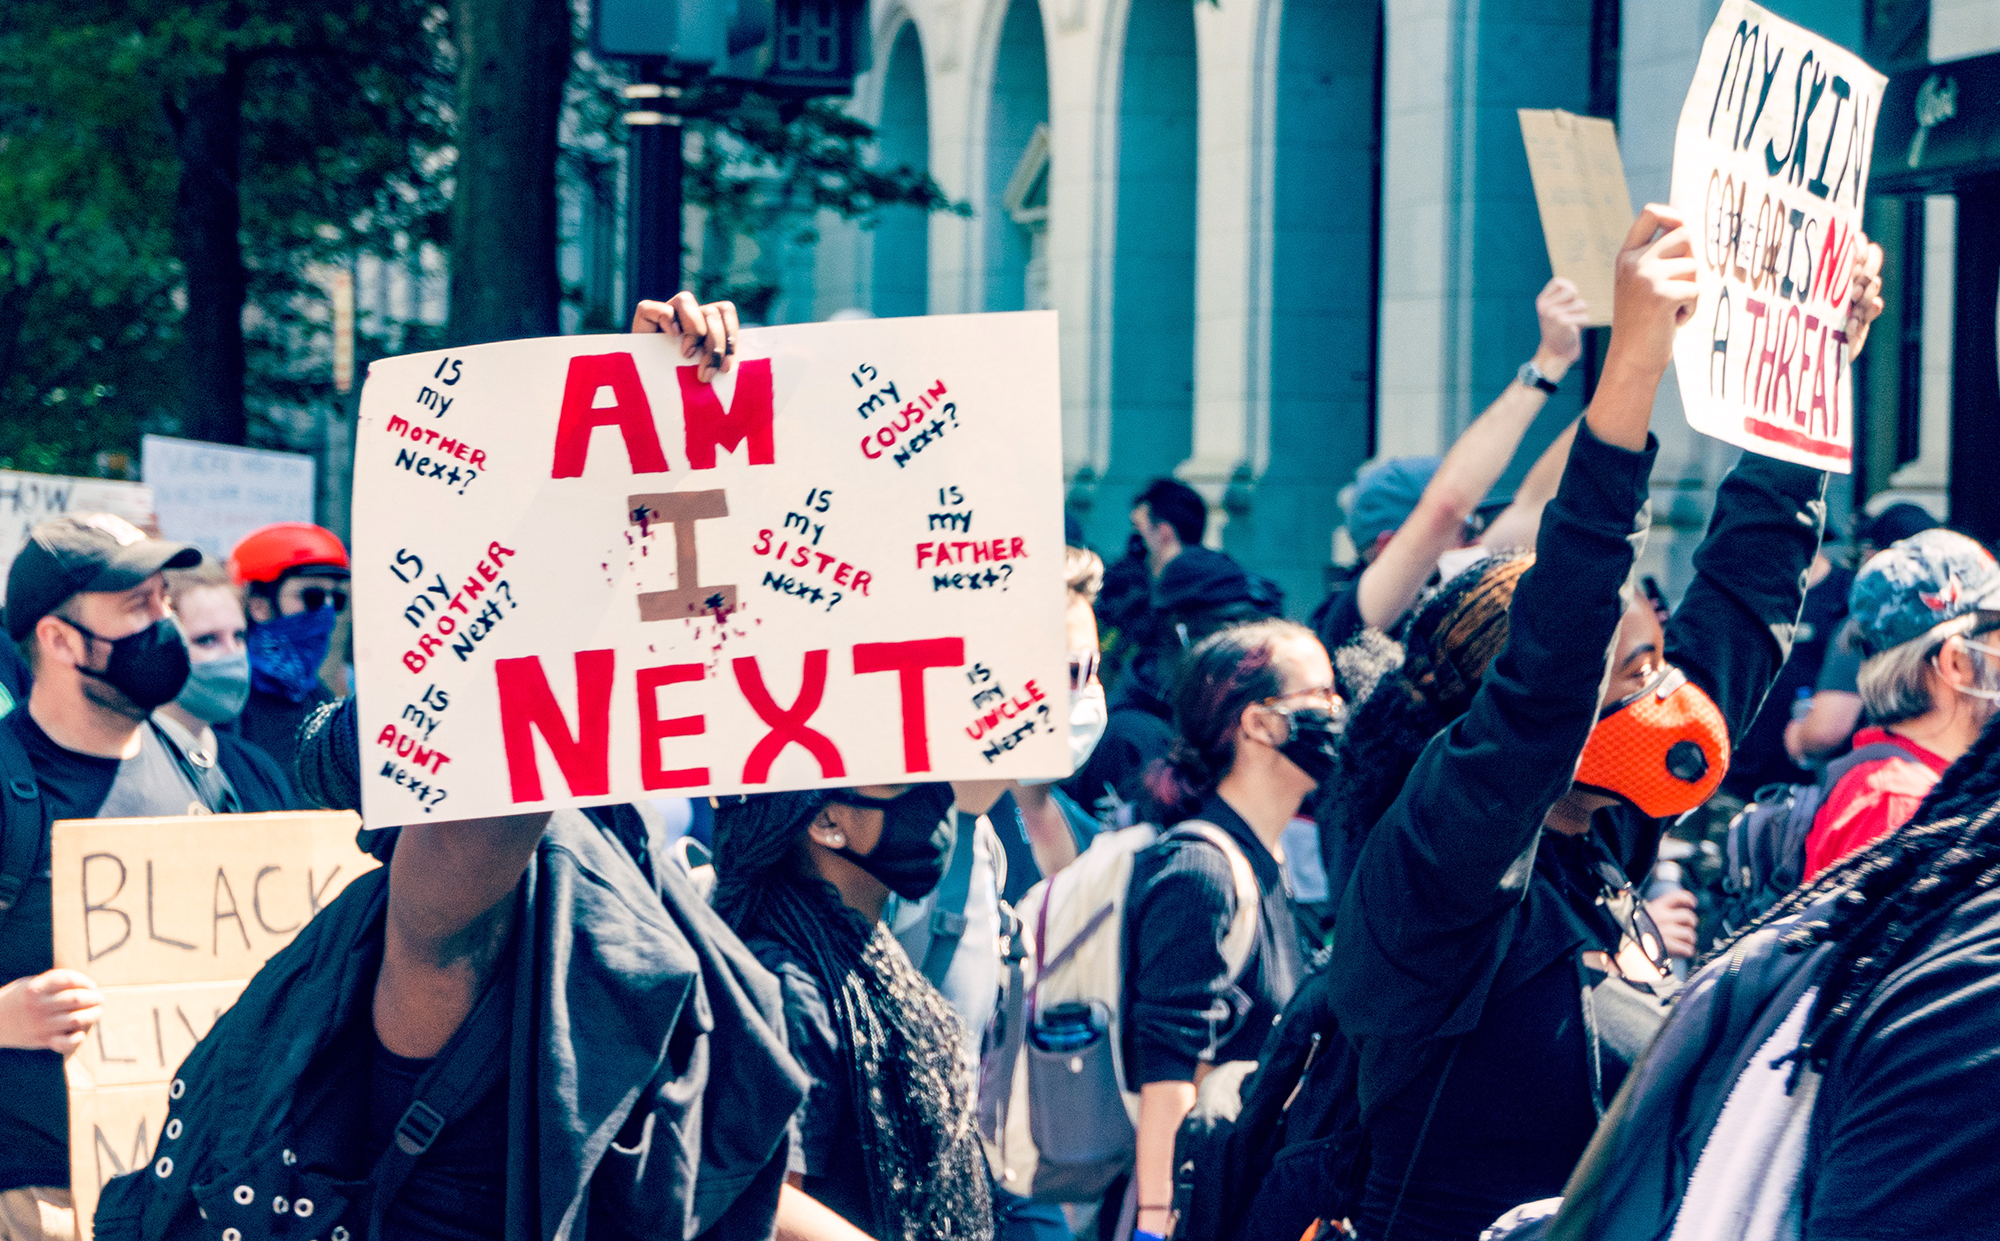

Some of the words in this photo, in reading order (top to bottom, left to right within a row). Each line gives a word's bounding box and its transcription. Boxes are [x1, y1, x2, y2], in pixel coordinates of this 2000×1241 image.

[1707, 20, 1784, 151] MY
[1765, 50, 1869, 209] SKIN
[1704, 167, 1785, 296] COLOR
[1779, 208, 1817, 304] IS
[1812, 216, 1856, 317] NO
[434, 357, 463, 386] IS
[851, 363, 878, 388] IS
[1710, 285, 1731, 399] A
[1744, 298, 1849, 437] THREAT
[386, 414, 487, 471] MOTHER
[552, 352, 775, 479] AM
[860, 379, 948, 460] COUSIN
[395, 448, 477, 495] Next?
[806, 488, 834, 513] IS
[940, 486, 964, 506] IS
[390, 548, 424, 584] IS
[627, 489, 738, 622] I
[753, 529, 873, 596] SISTER
[916, 537, 1028, 569] FATHER
[402, 541, 516, 674] BROTHER
[452, 580, 518, 662] Next?
[762, 571, 843, 612] Next?
[421, 684, 449, 711] IS
[966, 663, 991, 684] IS
[495, 637, 965, 803] NEXT
[965, 679, 1046, 740] UNCLE
[377, 724, 452, 775] AUNT
[83, 853, 341, 963] BLACK
